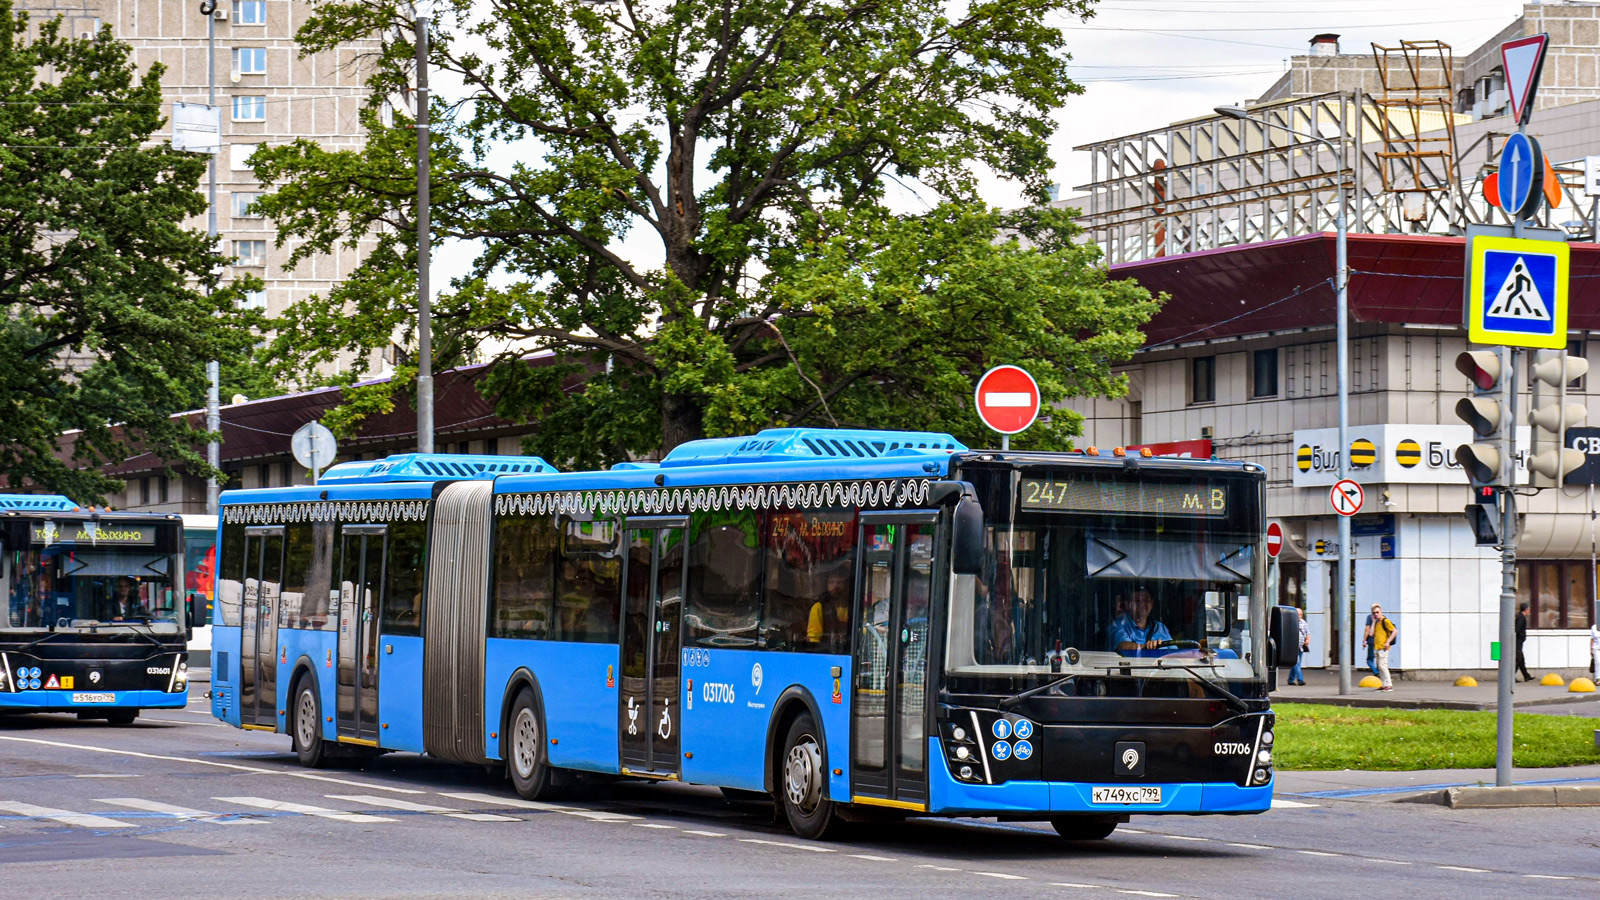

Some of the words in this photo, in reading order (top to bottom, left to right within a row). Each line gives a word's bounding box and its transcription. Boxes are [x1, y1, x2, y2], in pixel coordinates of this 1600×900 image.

[1026, 481, 1068, 504] 247
[1211, 488, 1225, 510] В
[771, 517, 789, 537] 247
[811, 516, 845, 537] Выхино
[94, 527, 142, 541] Выхино
[147, 667, 170, 675] 031601
[703, 682, 735, 704] 031706
[1214, 742, 1251, 755] 031706
[1095, 788, 1139, 802] К749ХС
[1141, 788, 1158, 798] 799
